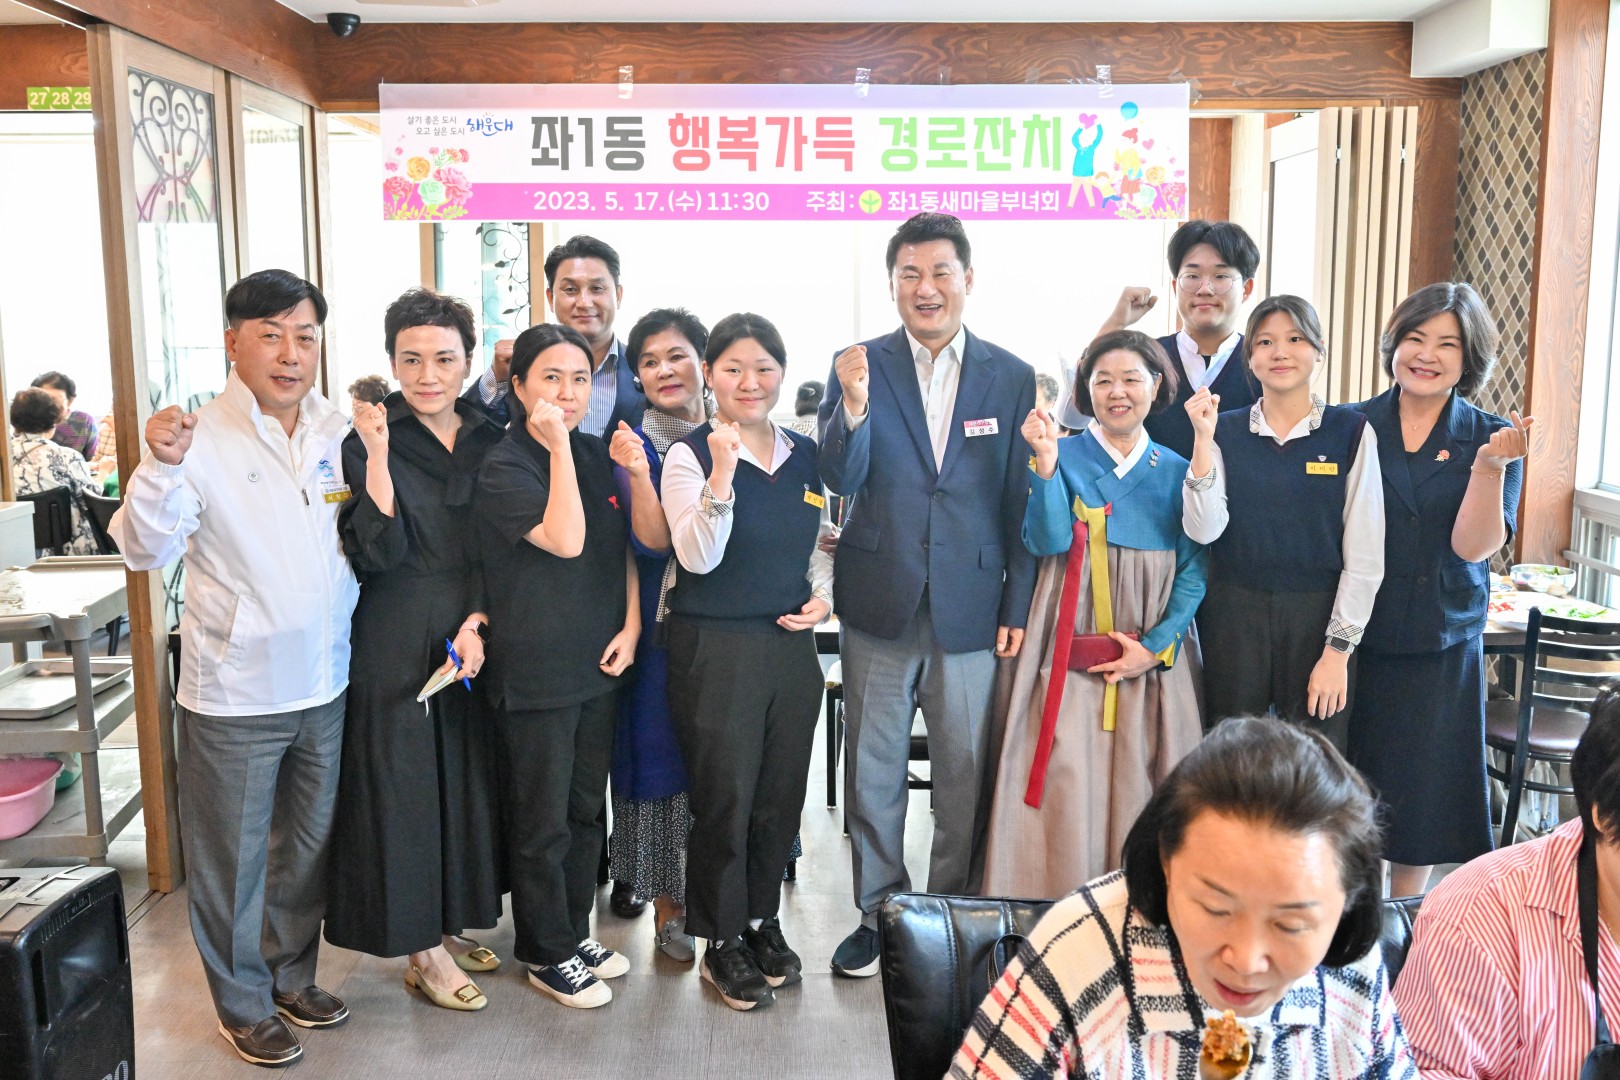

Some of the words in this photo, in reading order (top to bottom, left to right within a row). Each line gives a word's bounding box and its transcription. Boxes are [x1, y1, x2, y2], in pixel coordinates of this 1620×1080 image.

[30, 92, 47, 105] 27
[52, 92, 70, 105] 28
[74, 92, 91, 105] 29
[407, 115, 422, 125] 살기
[425, 115, 439, 125] 좋은
[442, 115, 457, 124] 도시
[466, 118, 513, 136] 해운대
[416, 127, 430, 135] 오고
[434, 127, 447, 136] 싶은
[450, 127, 465, 135] 도시
[531, 116, 645, 171] 좌1동
[668, 113, 855, 171] 행복가득
[879, 114, 1061, 171] 경로잔치
[533, 191, 596, 211] 2023.
[605, 191, 624, 211] 5.
[887, 190, 1060, 212] 좌1동새마을부녀회
